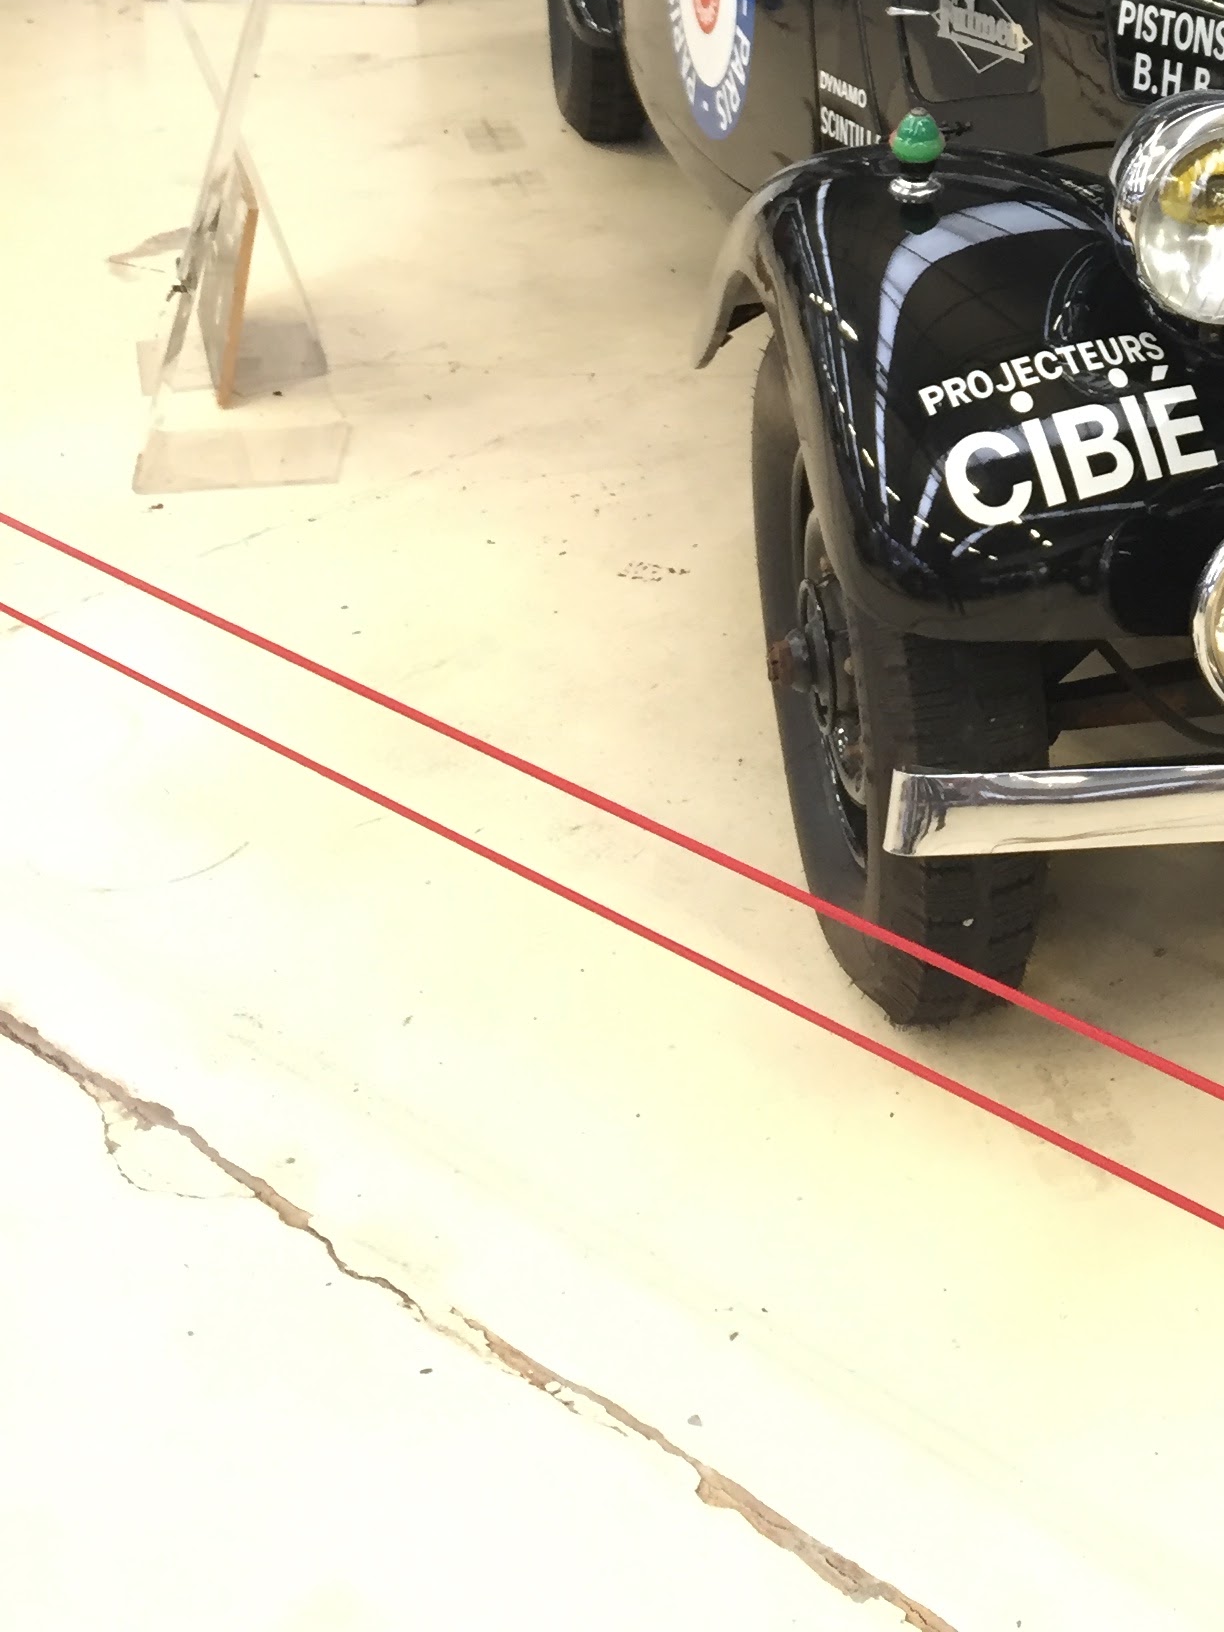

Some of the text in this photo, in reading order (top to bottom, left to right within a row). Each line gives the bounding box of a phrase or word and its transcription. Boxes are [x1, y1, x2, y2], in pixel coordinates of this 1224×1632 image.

[715, 24, 751, 131] PARIS
[819, 70, 868, 108] DYNAMO
[918, 332, 1165, 416] PROJECTEURS
